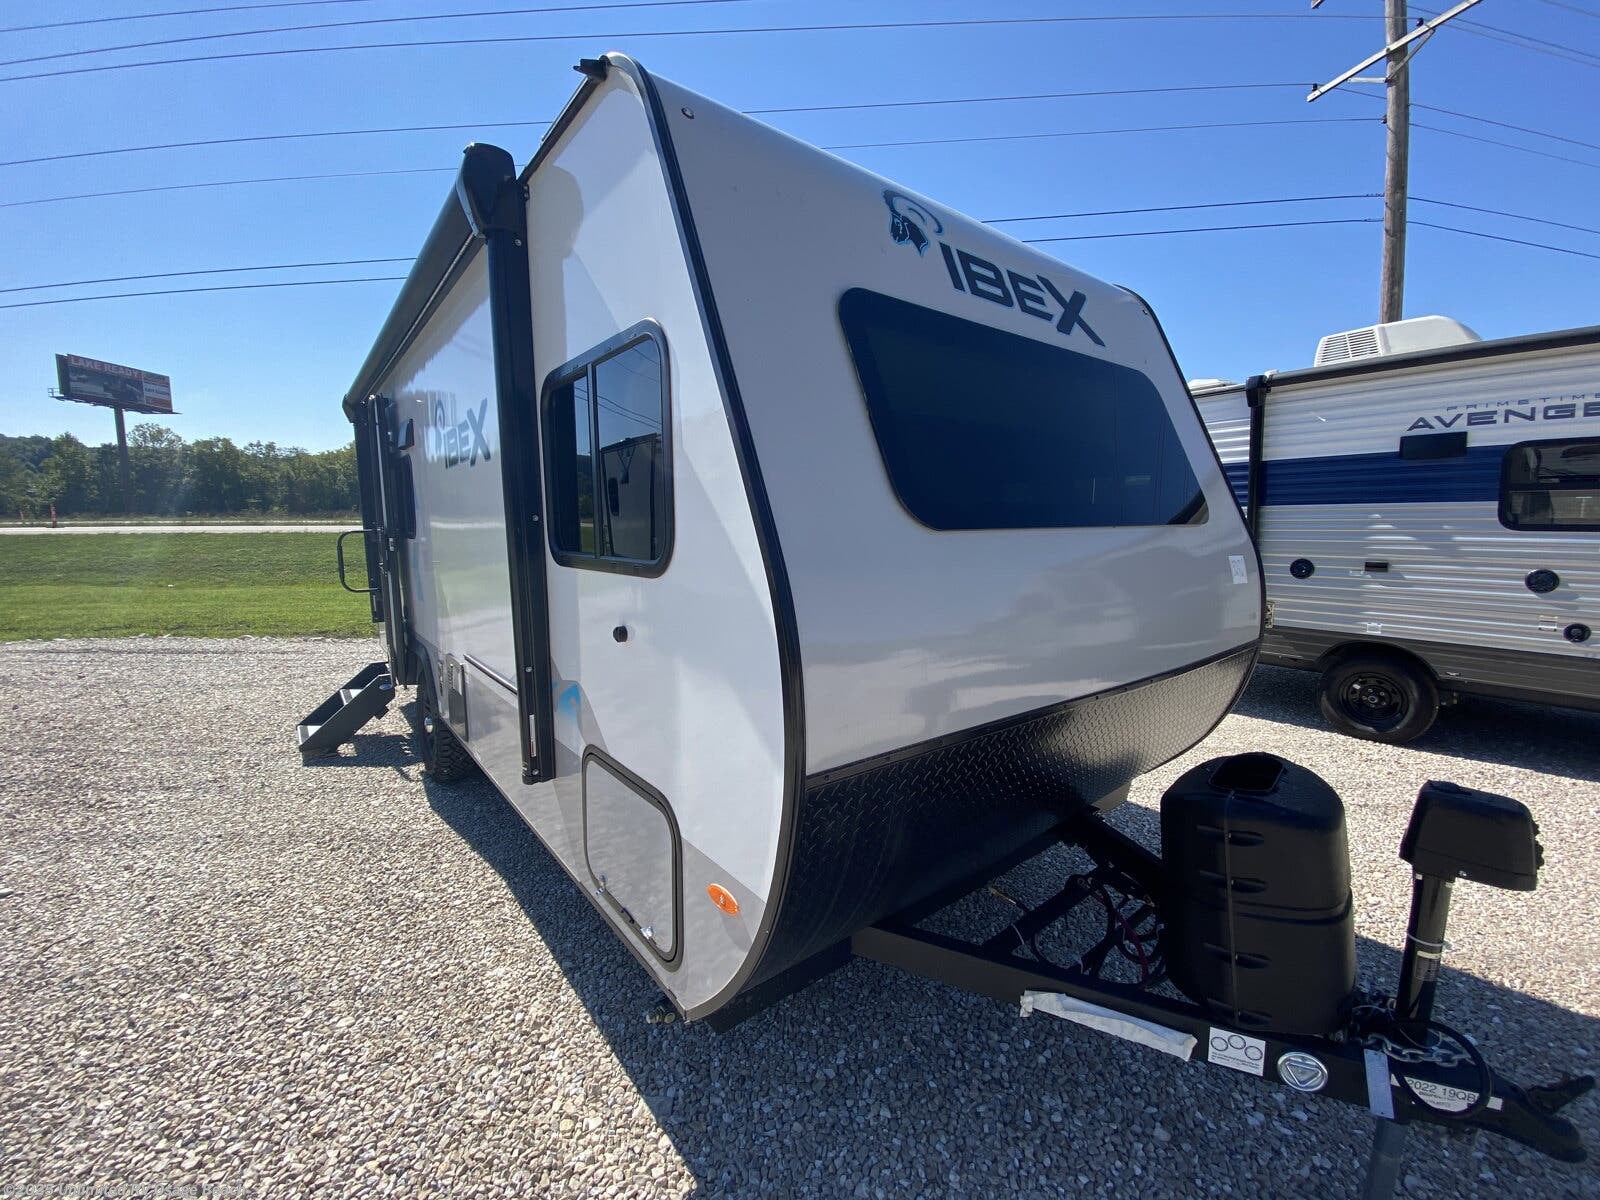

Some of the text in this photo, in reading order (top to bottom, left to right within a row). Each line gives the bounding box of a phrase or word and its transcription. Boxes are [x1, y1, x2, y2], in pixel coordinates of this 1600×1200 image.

[939, 241, 1106, 347] IBEX
[70, 355, 139, 377] LAKE READY
[443, 397, 491, 469] IBEX
[1407, 1078, 1437, 1094] 2022
